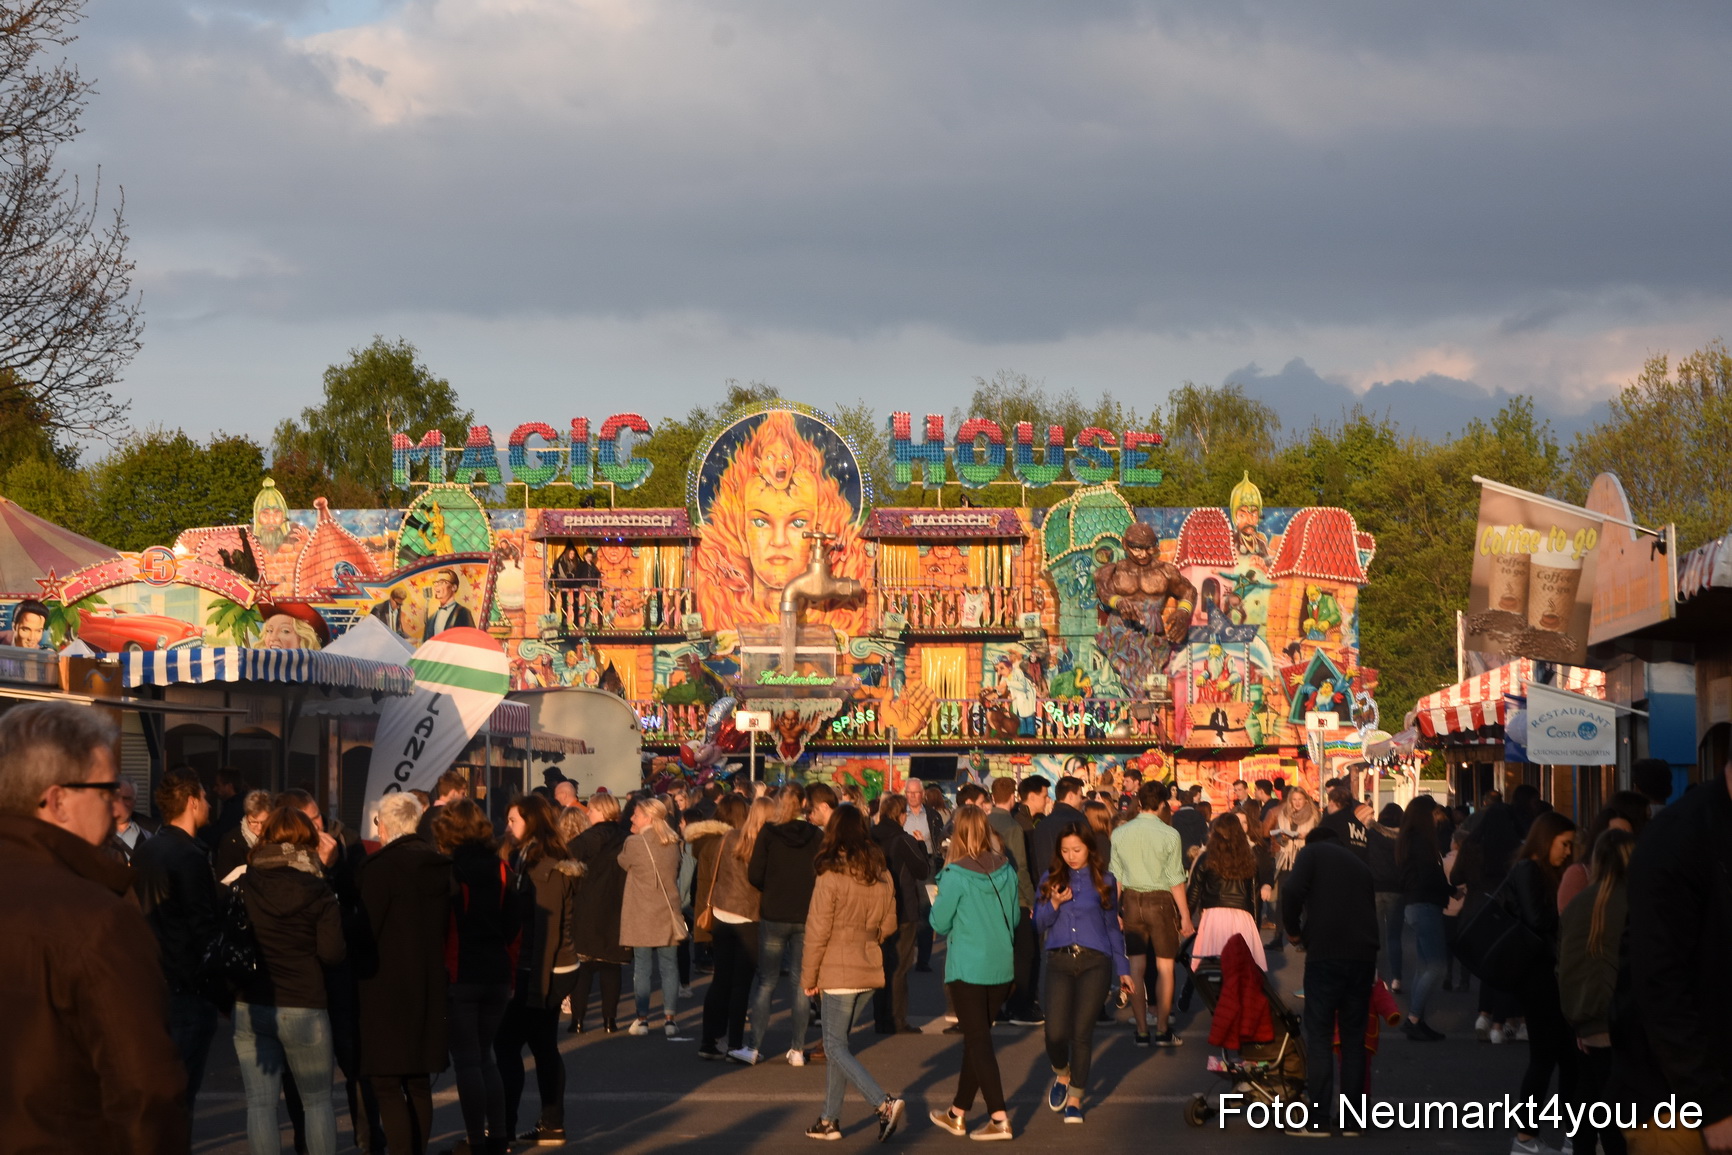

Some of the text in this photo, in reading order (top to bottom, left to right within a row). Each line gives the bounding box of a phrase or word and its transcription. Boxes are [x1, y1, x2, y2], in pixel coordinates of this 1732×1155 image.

[392, 411, 1163, 490] MAGIC HOUSE
[563, 515, 673, 527] PHANTASTISCH
[911, 514, 988, 526] MAGISCH
[1480, 524, 1597, 561] Coffee to go
[1496, 556, 1528, 568] Coffee
[1513, 569, 1526, 577] go
[1536, 570, 1571, 584] Coffee
[1542, 583, 1571, 595] to go
[832, 709, 875, 734] SPASS
[1044, 701, 1115, 734] GRUSELN
[1531, 707, 1611, 728] RESTAURANT
